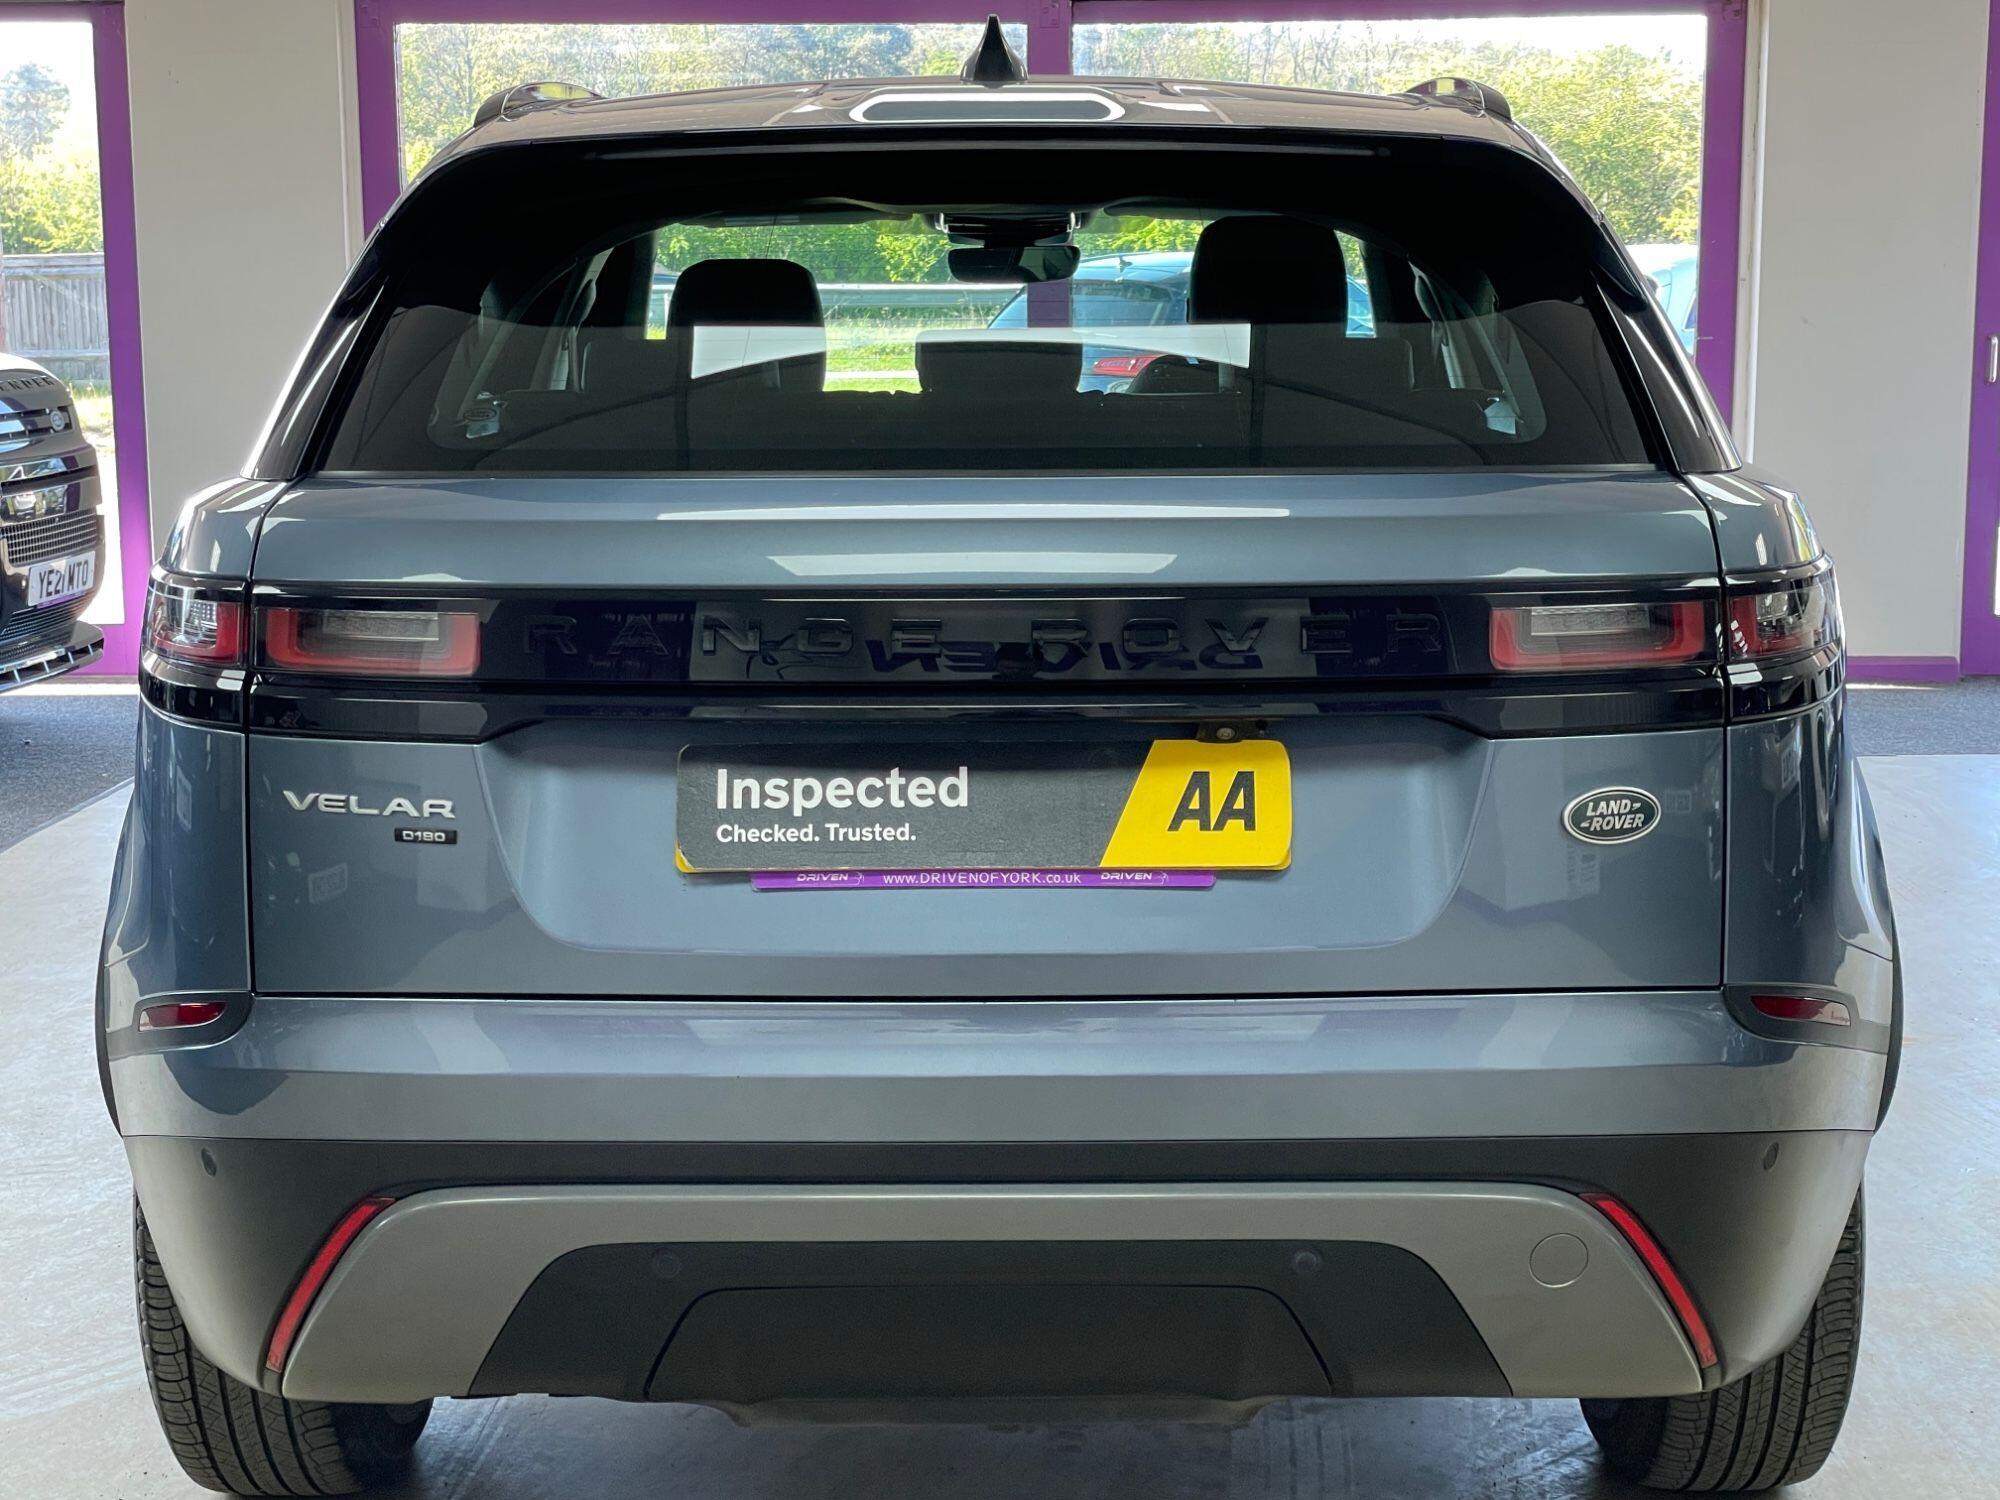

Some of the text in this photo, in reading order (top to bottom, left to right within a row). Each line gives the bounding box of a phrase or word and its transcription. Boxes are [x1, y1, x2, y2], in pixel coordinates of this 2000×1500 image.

[522, 612, 1445, 655] RANGE ROVER
[717, 766, 968, 817] Inspected
[282, 790, 456, 819] VELAR
[1167, 771, 1257, 831] AA
[1586, 799, 1632, 816] LAND
[1590, 814, 1645, 831] ROVER
[402, 830, 446, 842] D180
[716, 823, 917, 842] Checked. Trusted.
[796, 873, 849, 881] DRIVEN
[883, 872, 1081, 884] www.DRIVENOFYORK.co.uk
[1101, 872, 1153, 880] DRIVEN
